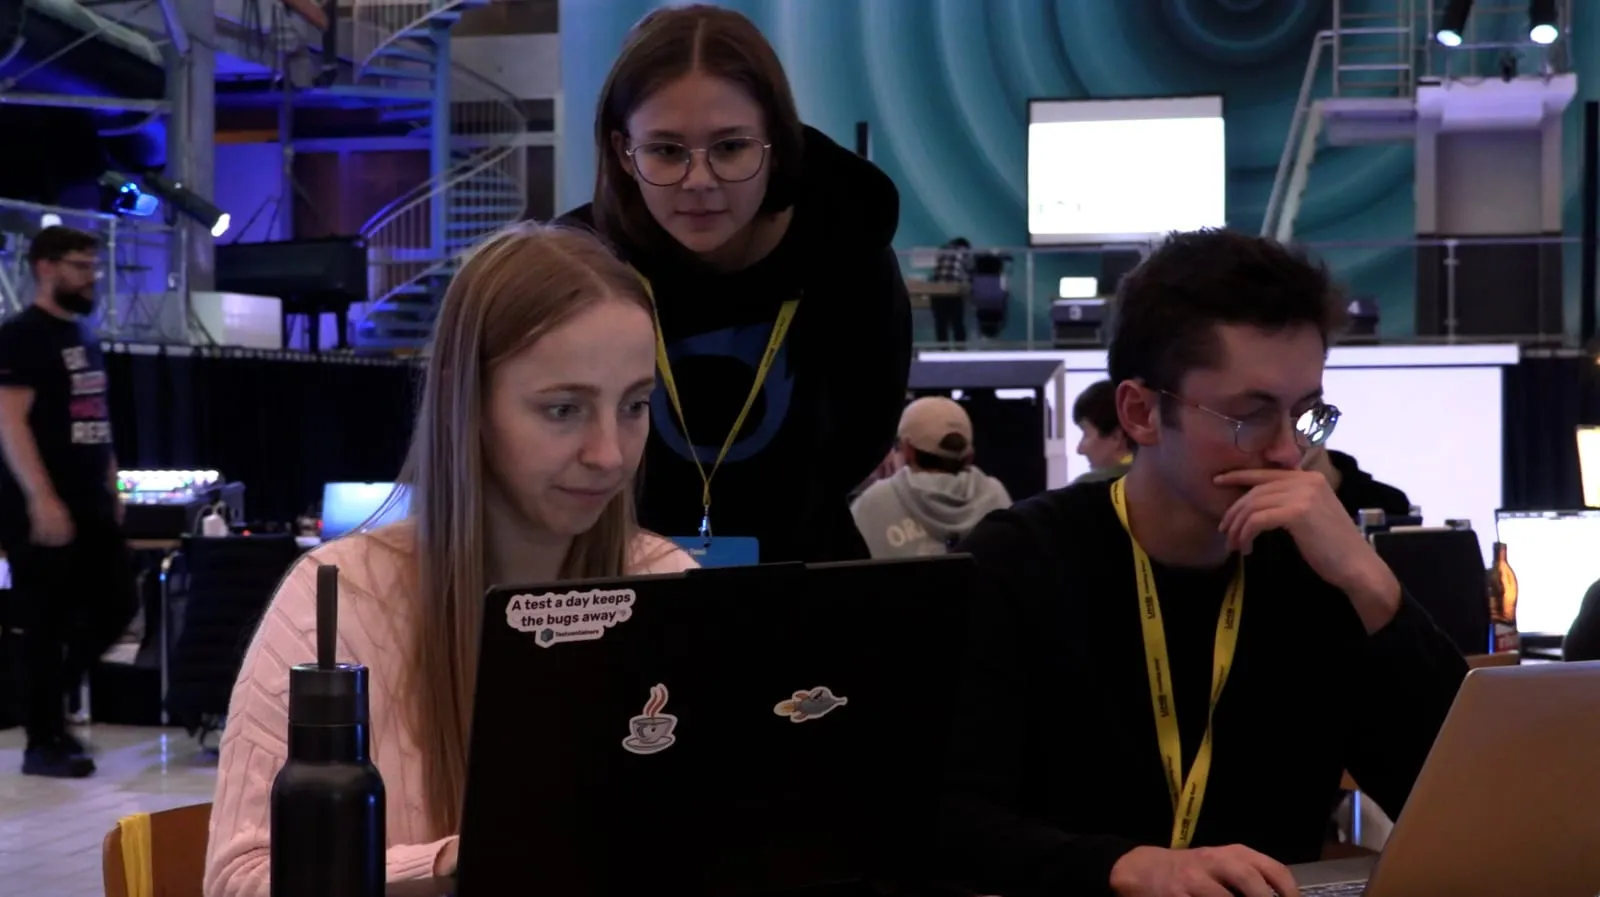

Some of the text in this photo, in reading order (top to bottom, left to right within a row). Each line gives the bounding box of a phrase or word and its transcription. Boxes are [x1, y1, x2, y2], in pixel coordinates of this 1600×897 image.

[511, 593, 631, 612] A test a day keeps
[521, 611, 617, 627] the bugs away
